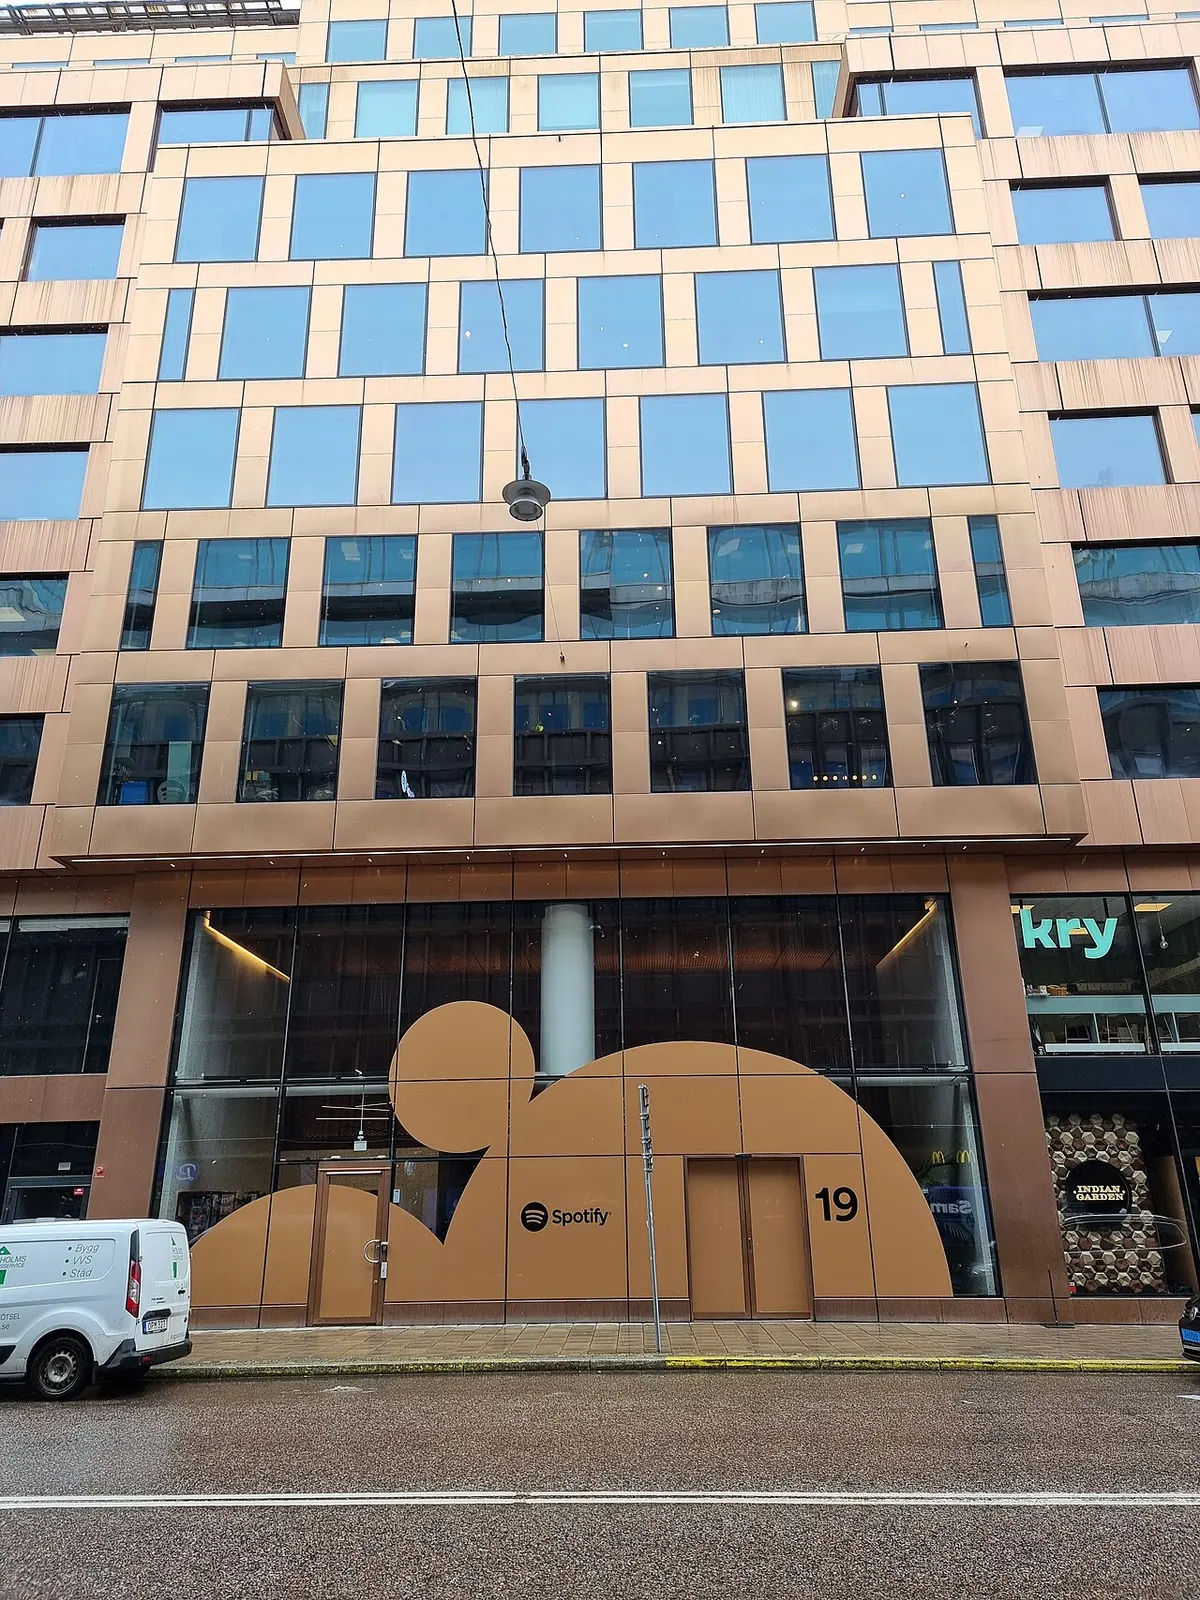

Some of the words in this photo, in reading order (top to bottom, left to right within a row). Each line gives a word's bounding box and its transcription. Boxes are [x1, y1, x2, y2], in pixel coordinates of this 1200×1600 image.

[1019, 908, 1118, 959] kry
[1076, 1185, 1121, 1193] INDIAN
[1076, 1193, 1124, 1201] GARDEN
[814, 1186, 859, 1222] 19
[551, 1207, 609, 1227] Spotify
[75, 1243, 100, 1254] Bygg
[73, 1255, 93, 1265] VVS
